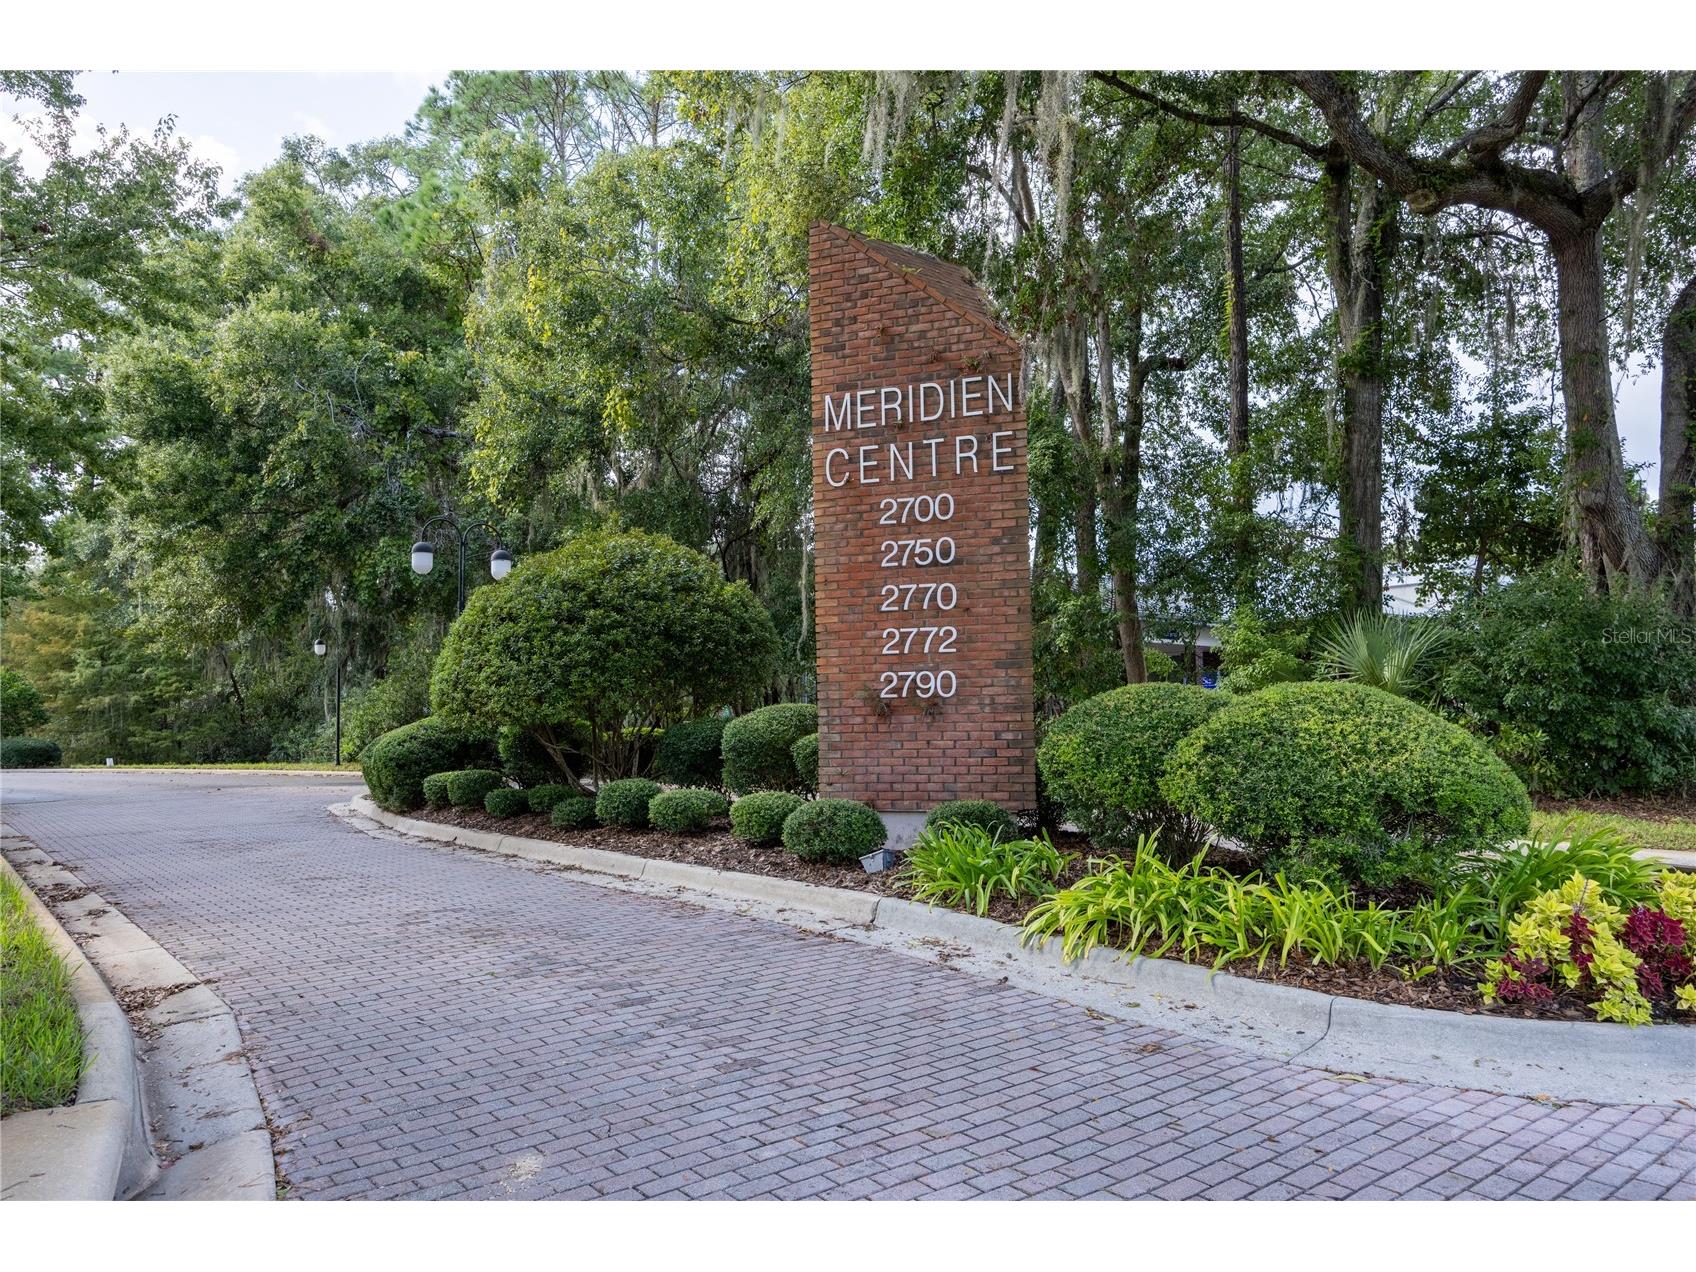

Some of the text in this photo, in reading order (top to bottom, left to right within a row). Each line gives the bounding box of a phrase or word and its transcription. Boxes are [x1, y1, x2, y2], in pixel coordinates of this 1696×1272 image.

[824, 373, 1012, 431] MERIDIEN
[825, 431, 1014, 487] CENTRE
[879, 493, 955, 525] 2700
[880, 536, 956, 567] 2750
[880, 583, 957, 612] 2770
[881, 626, 957, 655] 2772
[880, 670, 957, 698] 2790
